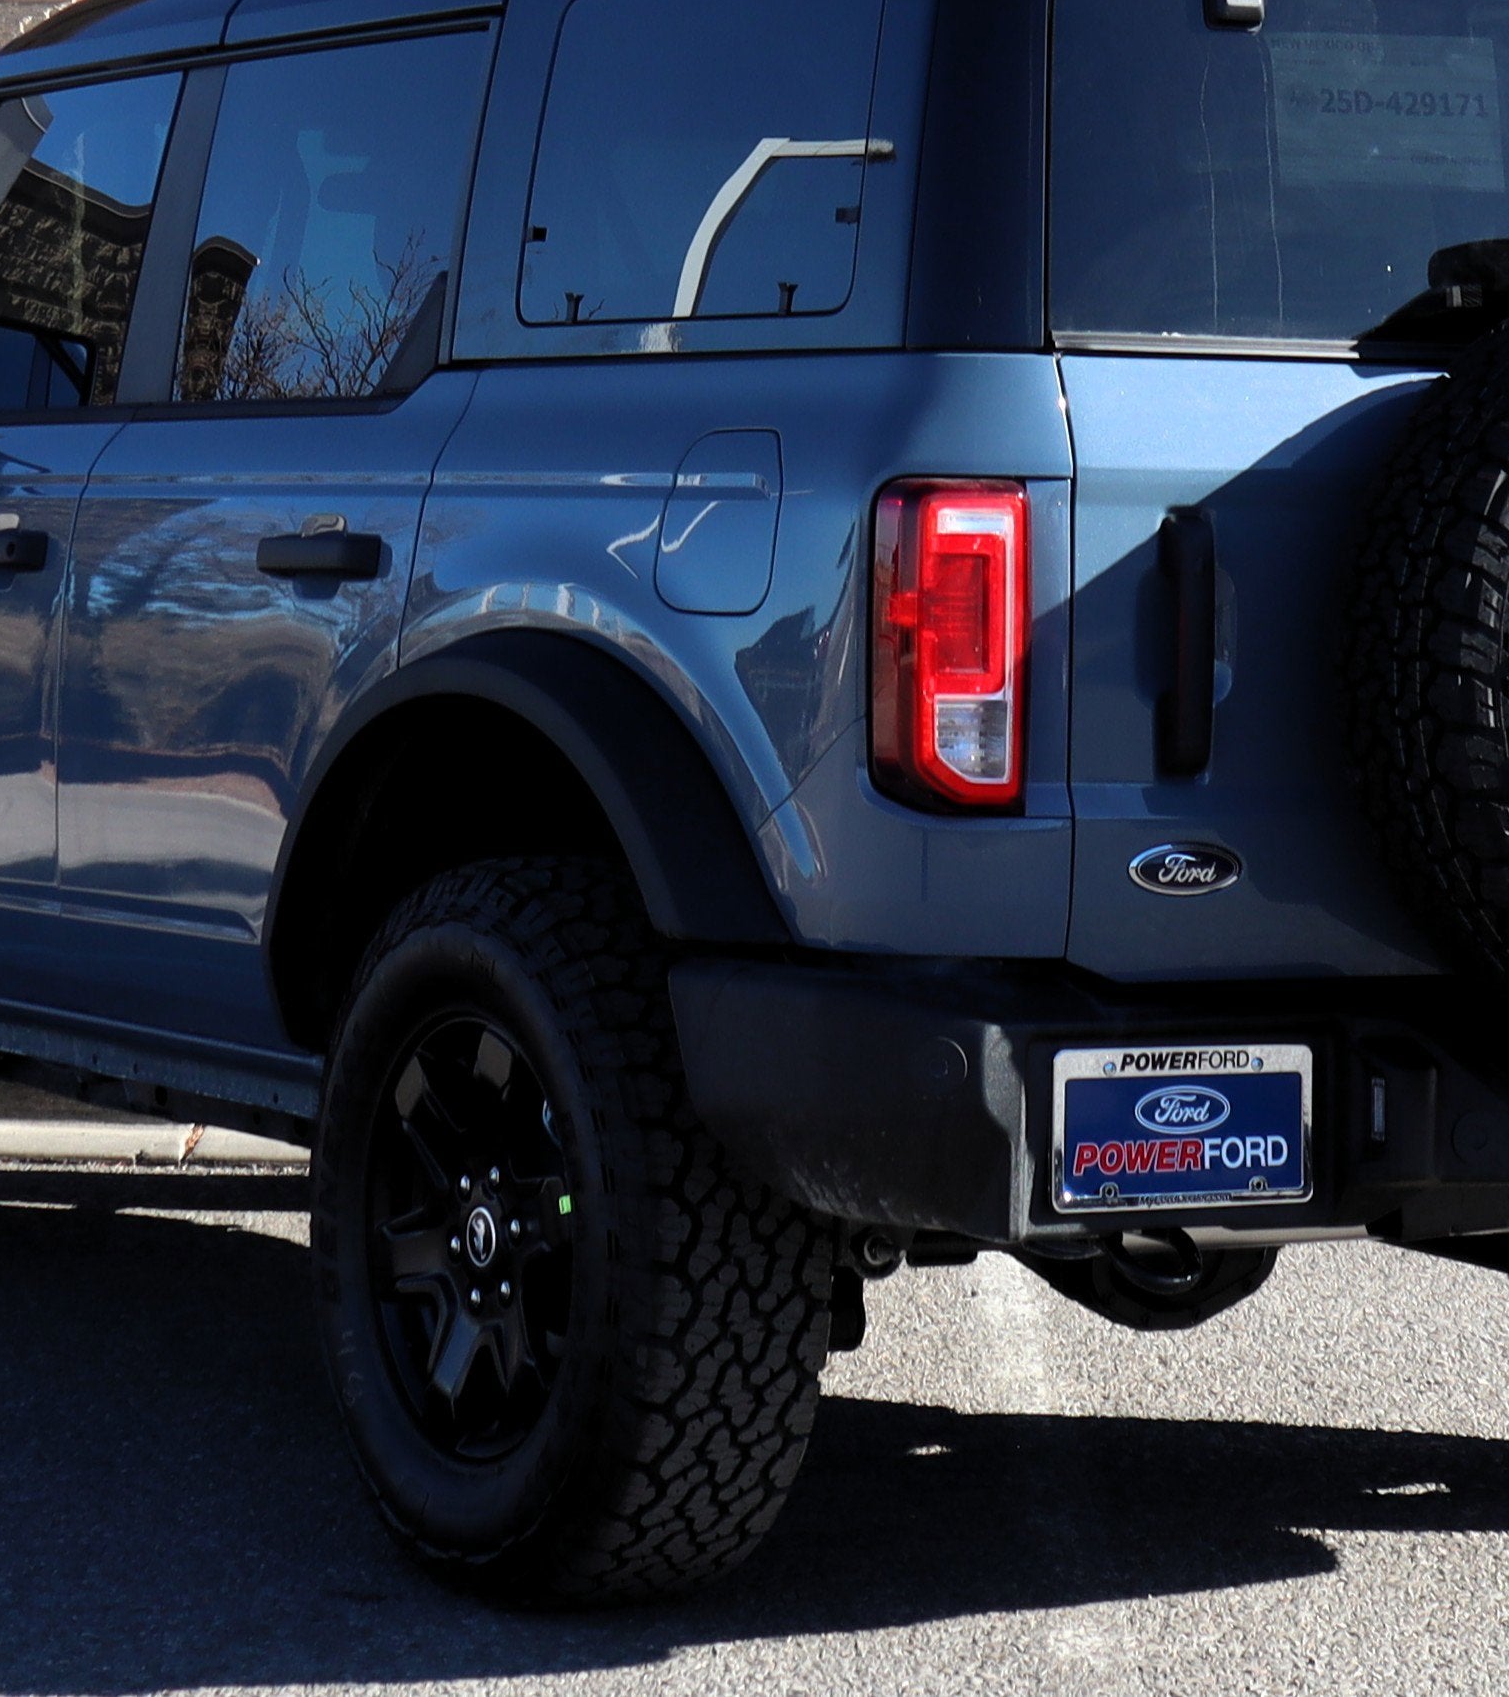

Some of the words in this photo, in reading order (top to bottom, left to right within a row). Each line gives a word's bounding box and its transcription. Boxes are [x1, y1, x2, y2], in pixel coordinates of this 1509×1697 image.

[1320, 88, 1489, 118] 25D-429171
[1157, 853, 1218, 883] Ford
[1119, 1049, 1251, 1073] POWERFORD
[1153, 1094, 1210, 1124] Ford
[1072, 1134, 1289, 1177] POWERFORD
